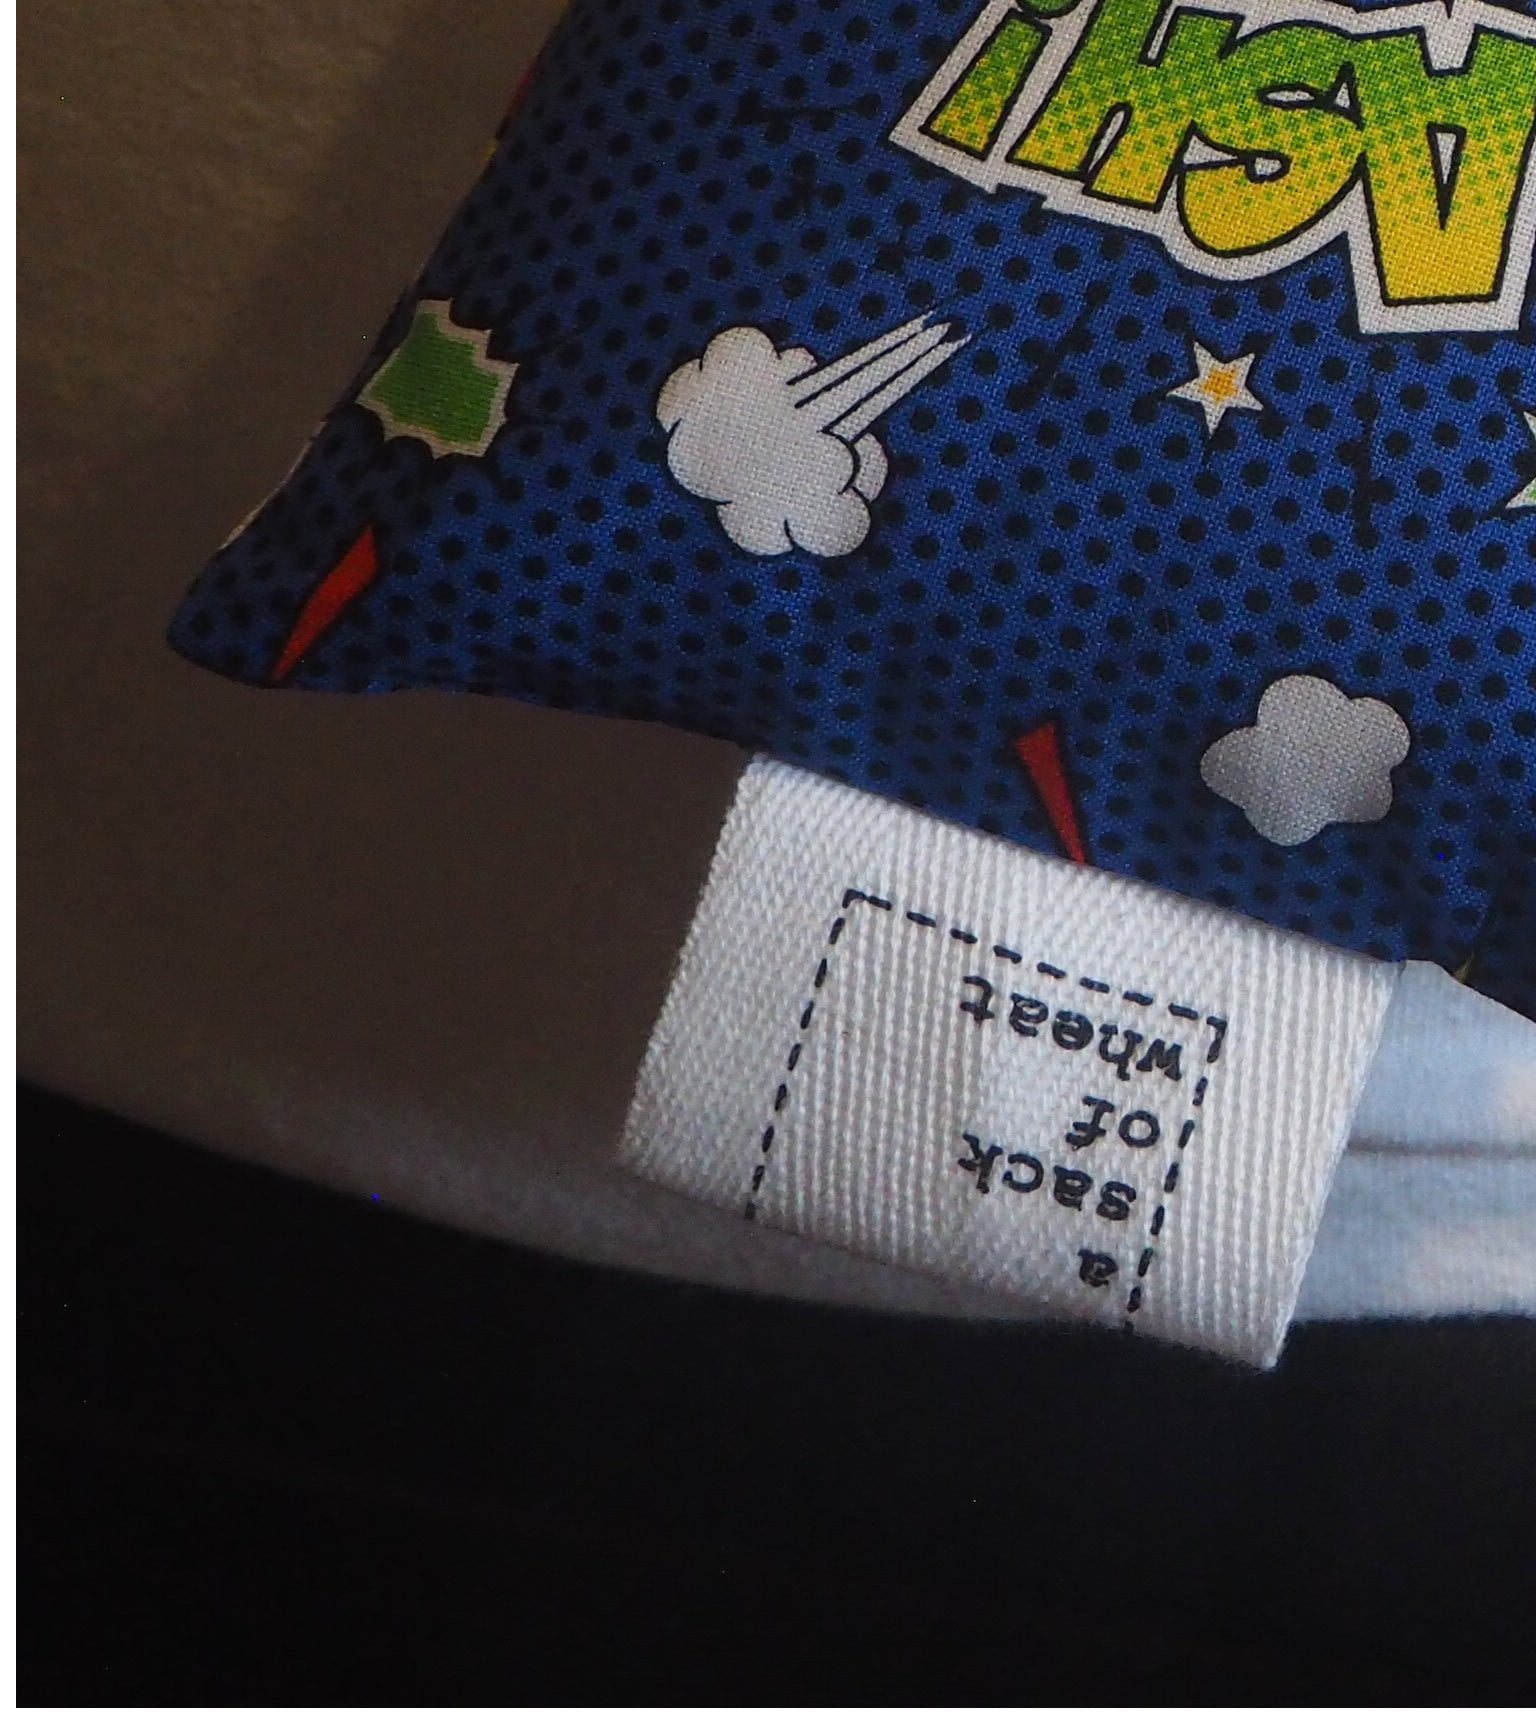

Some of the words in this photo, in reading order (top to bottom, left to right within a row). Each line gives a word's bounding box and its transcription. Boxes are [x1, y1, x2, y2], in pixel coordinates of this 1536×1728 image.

[957, 974, 1186, 1083] wheat
[1064, 1093, 1163, 1152] of
[956, 1131, 1140, 1224] sack
[1077, 1247, 1121, 1290] a
